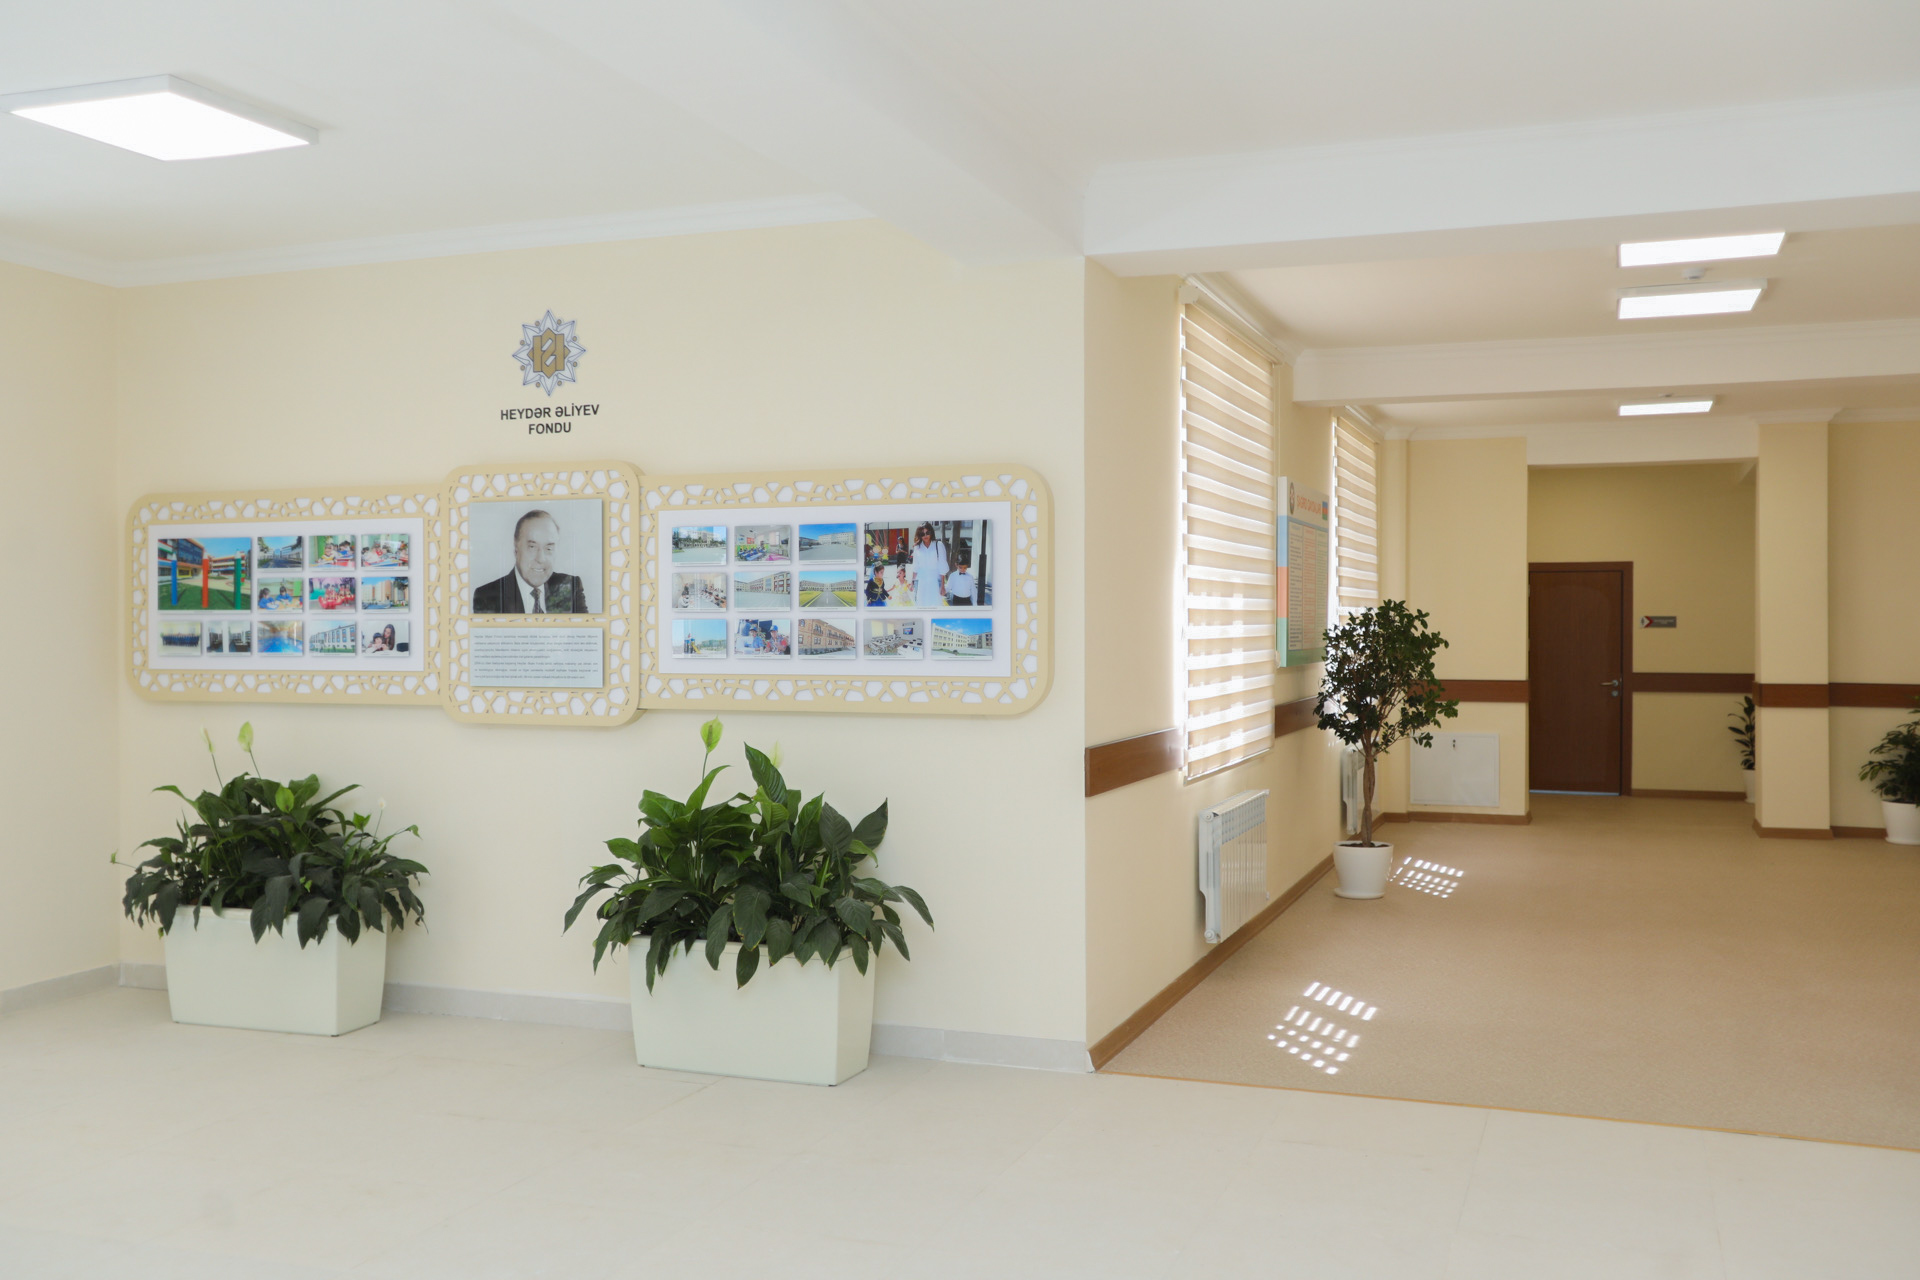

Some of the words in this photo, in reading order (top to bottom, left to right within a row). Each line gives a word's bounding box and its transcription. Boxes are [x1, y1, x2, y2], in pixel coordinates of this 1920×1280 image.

[500, 407, 551, 420] HEYDƏR
[555, 403, 600, 417] ƏLİYEV
[528, 422, 572, 434] FONDU
